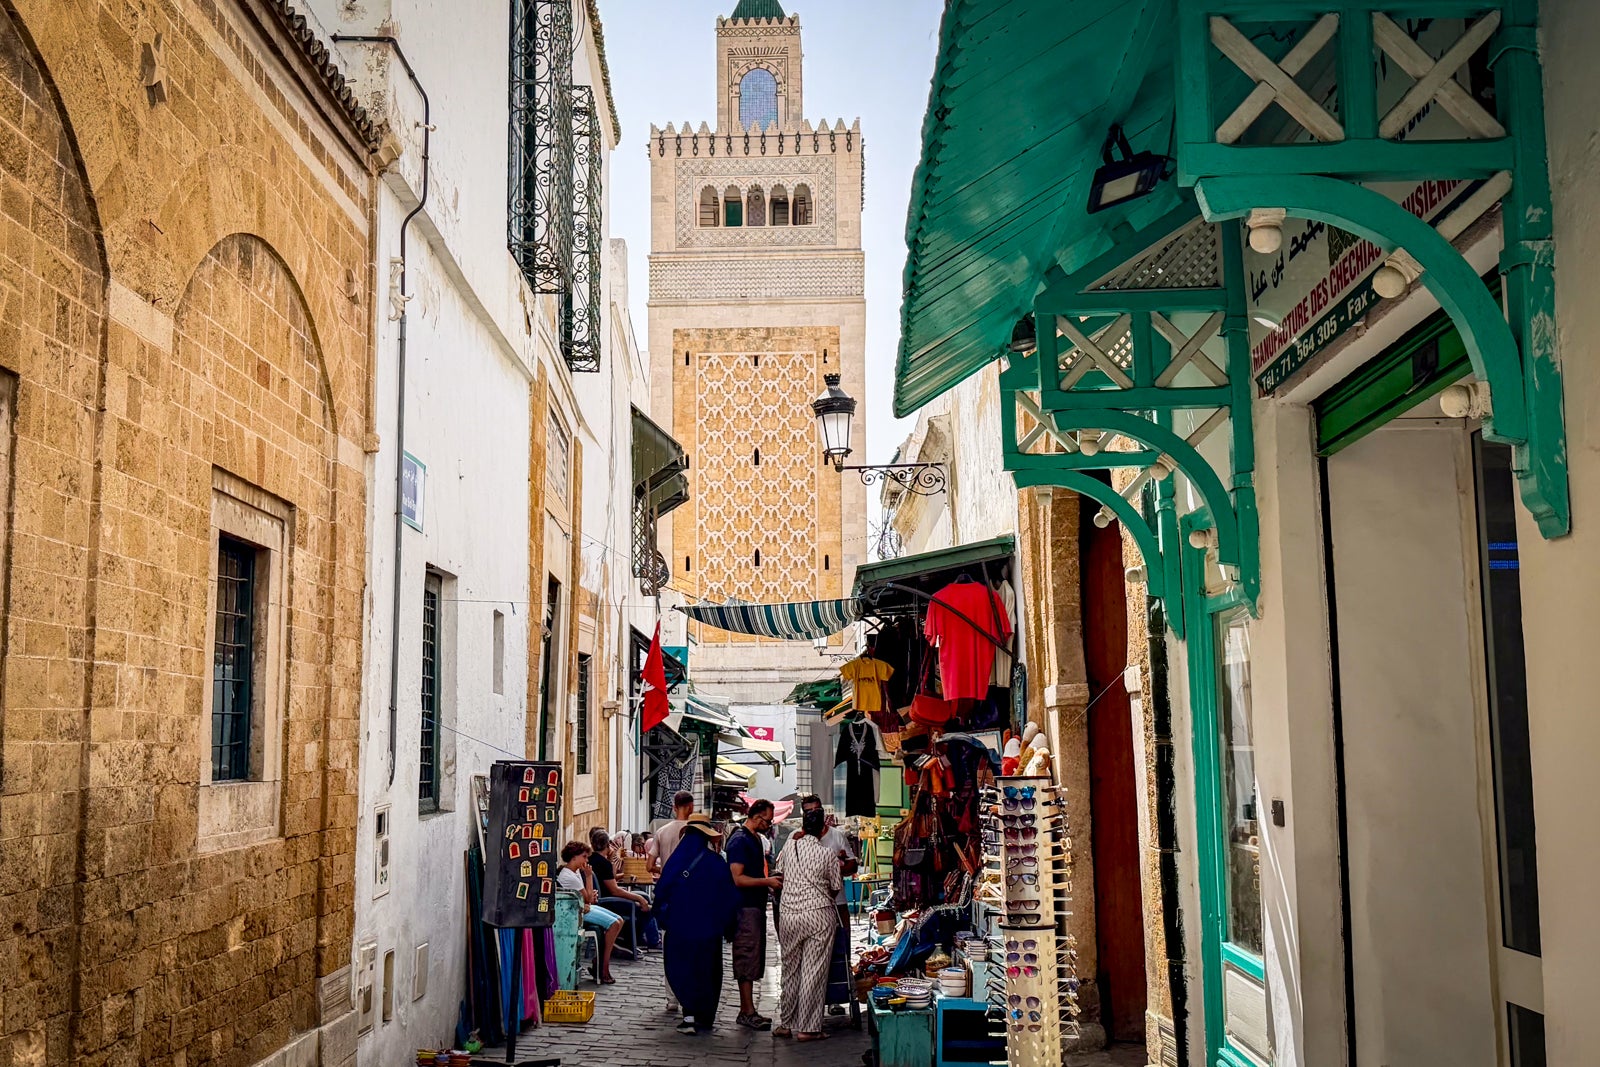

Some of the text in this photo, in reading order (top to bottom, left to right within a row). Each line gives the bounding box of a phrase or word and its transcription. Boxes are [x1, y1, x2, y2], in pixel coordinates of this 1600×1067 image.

[1252, 296, 1310, 373] MANUFACTURE
[1310, 277, 1329, 318] DES
[1297, 333, 1316, 362] 564
[1317, 314, 1338, 346] 305
[1347, 289, 1369, 321] Fax
